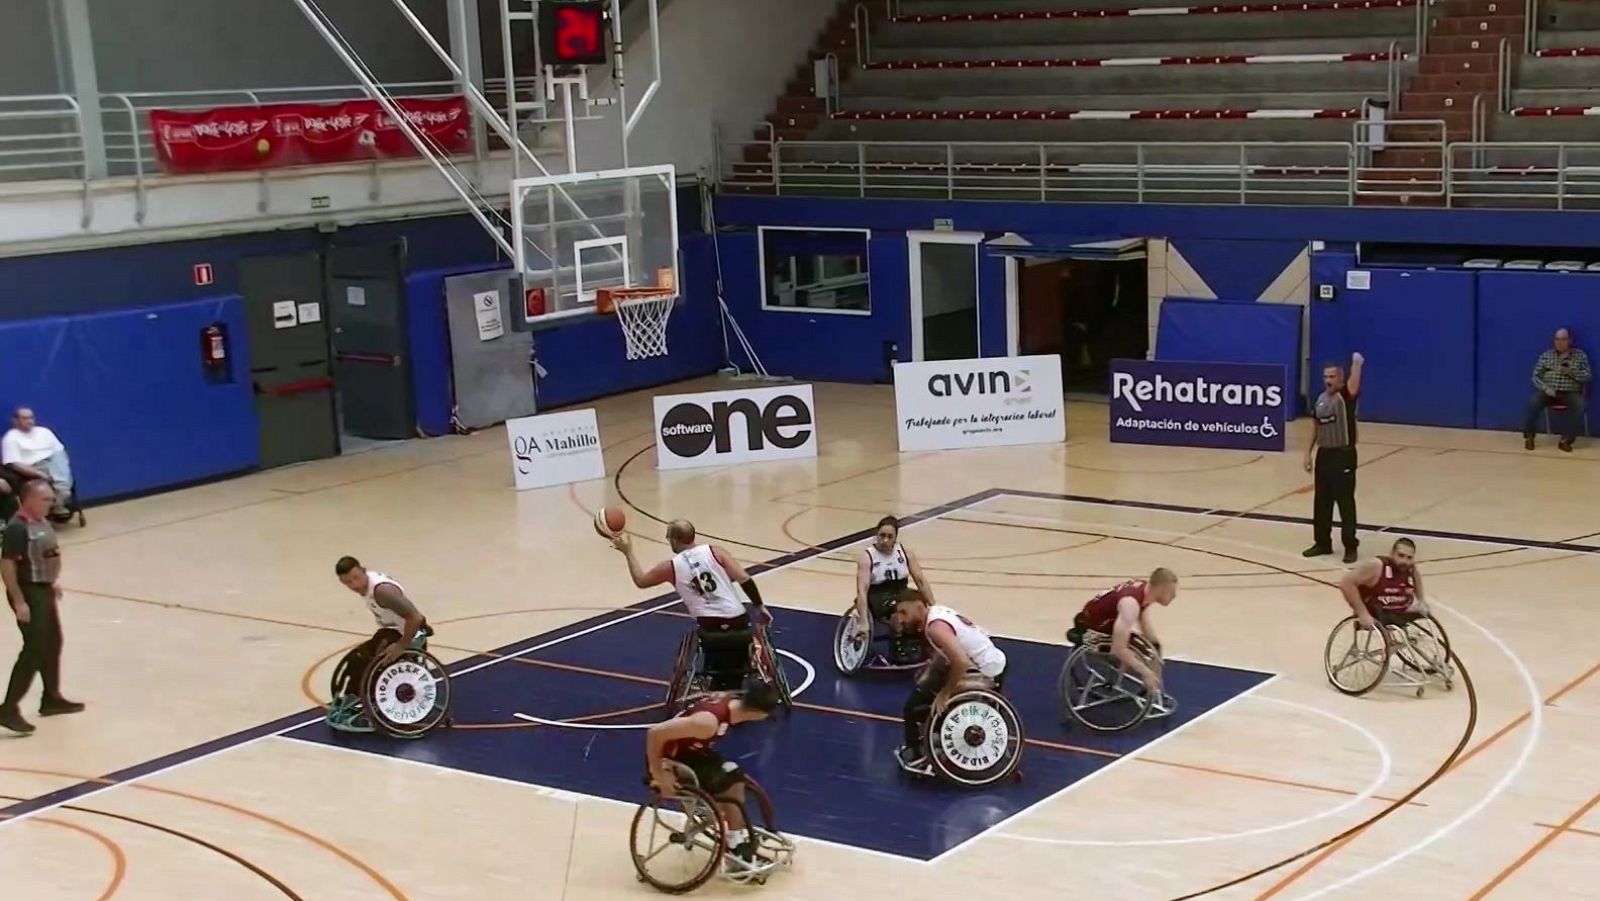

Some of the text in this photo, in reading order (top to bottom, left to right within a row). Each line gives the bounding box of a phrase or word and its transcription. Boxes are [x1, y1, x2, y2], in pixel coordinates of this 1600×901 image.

[1113, 372, 1282, 412] Rehatrans
[952, 417, 968, 428] por
[1027, 408, 1057, 419] laboral
[1116, 417, 1259, 435] Adaptación de vehículos
[662, 422, 713, 437] software
[545, 433, 597, 452] Mahillo
[690, 571, 717, 596] 13
